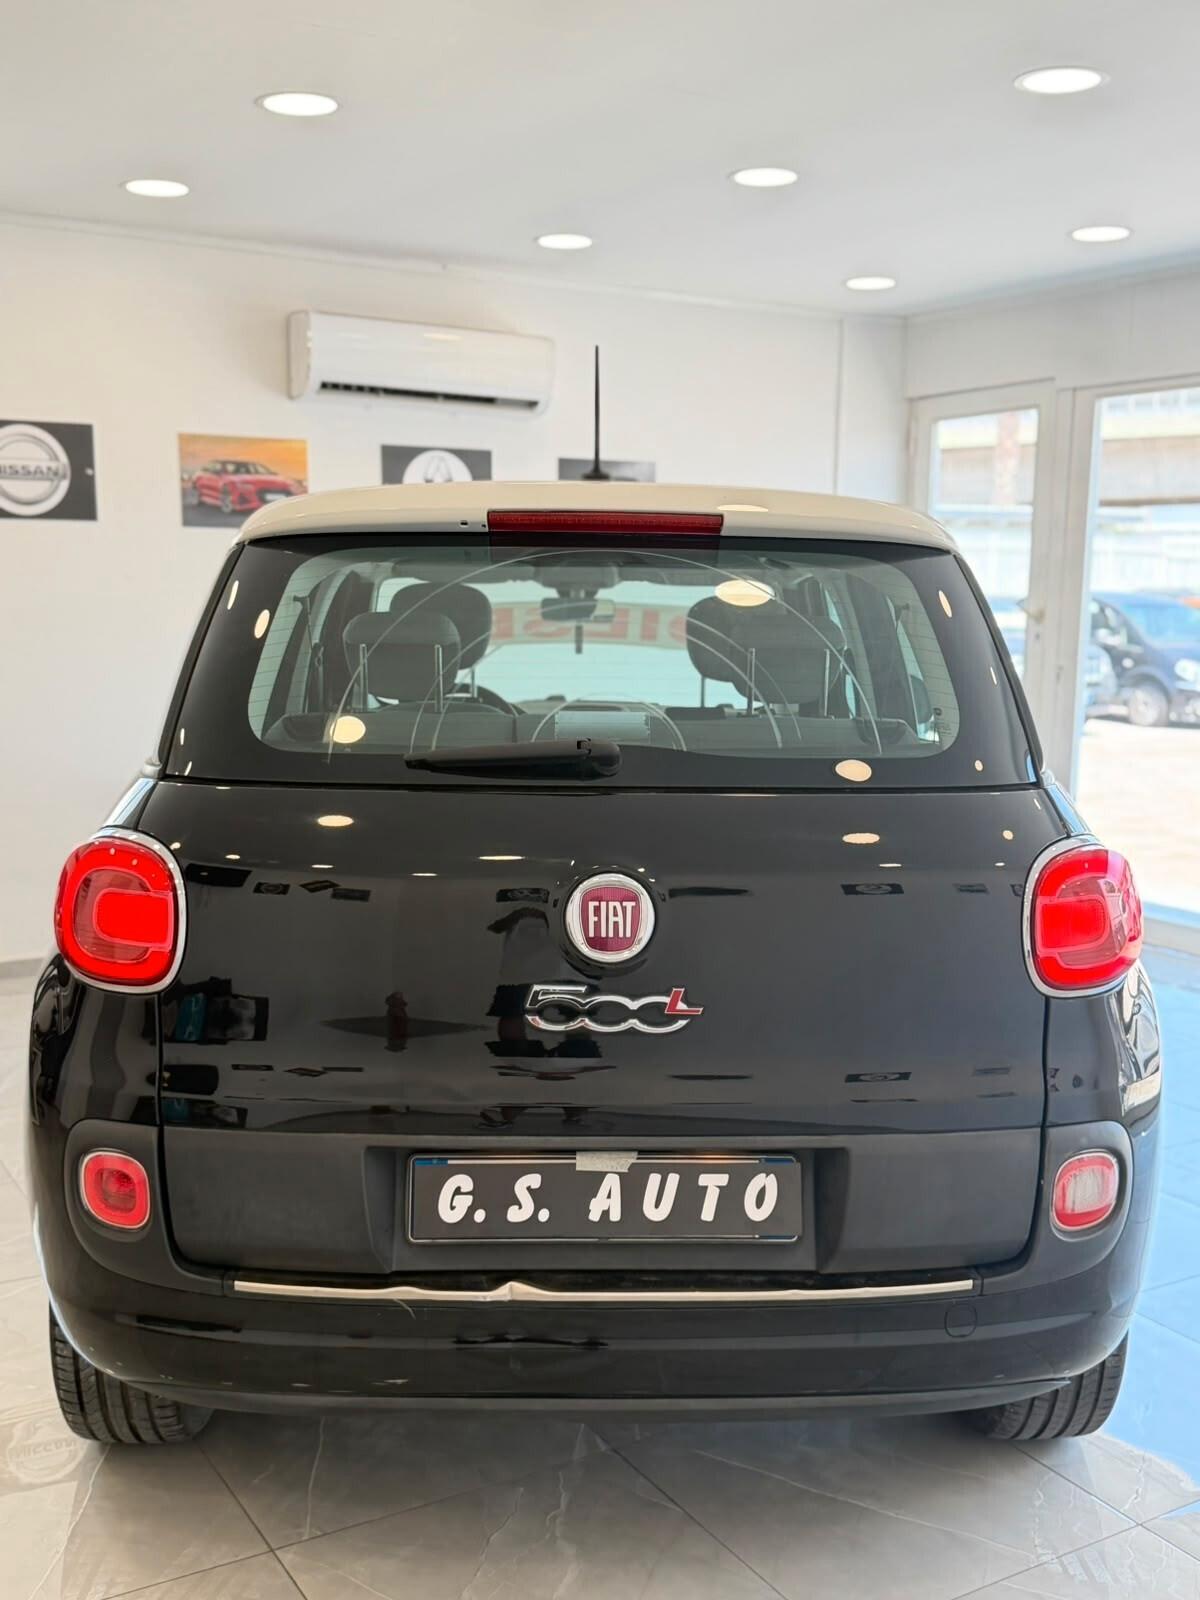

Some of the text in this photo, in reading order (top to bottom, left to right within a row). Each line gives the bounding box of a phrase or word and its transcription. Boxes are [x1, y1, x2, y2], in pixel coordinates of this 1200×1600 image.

[0, 464, 60, 477] ISSAN
[588, 901, 636, 938] FIAT
[525, 984, 704, 1033] 500L
[437, 1173, 778, 1223] G. S. AUTO
